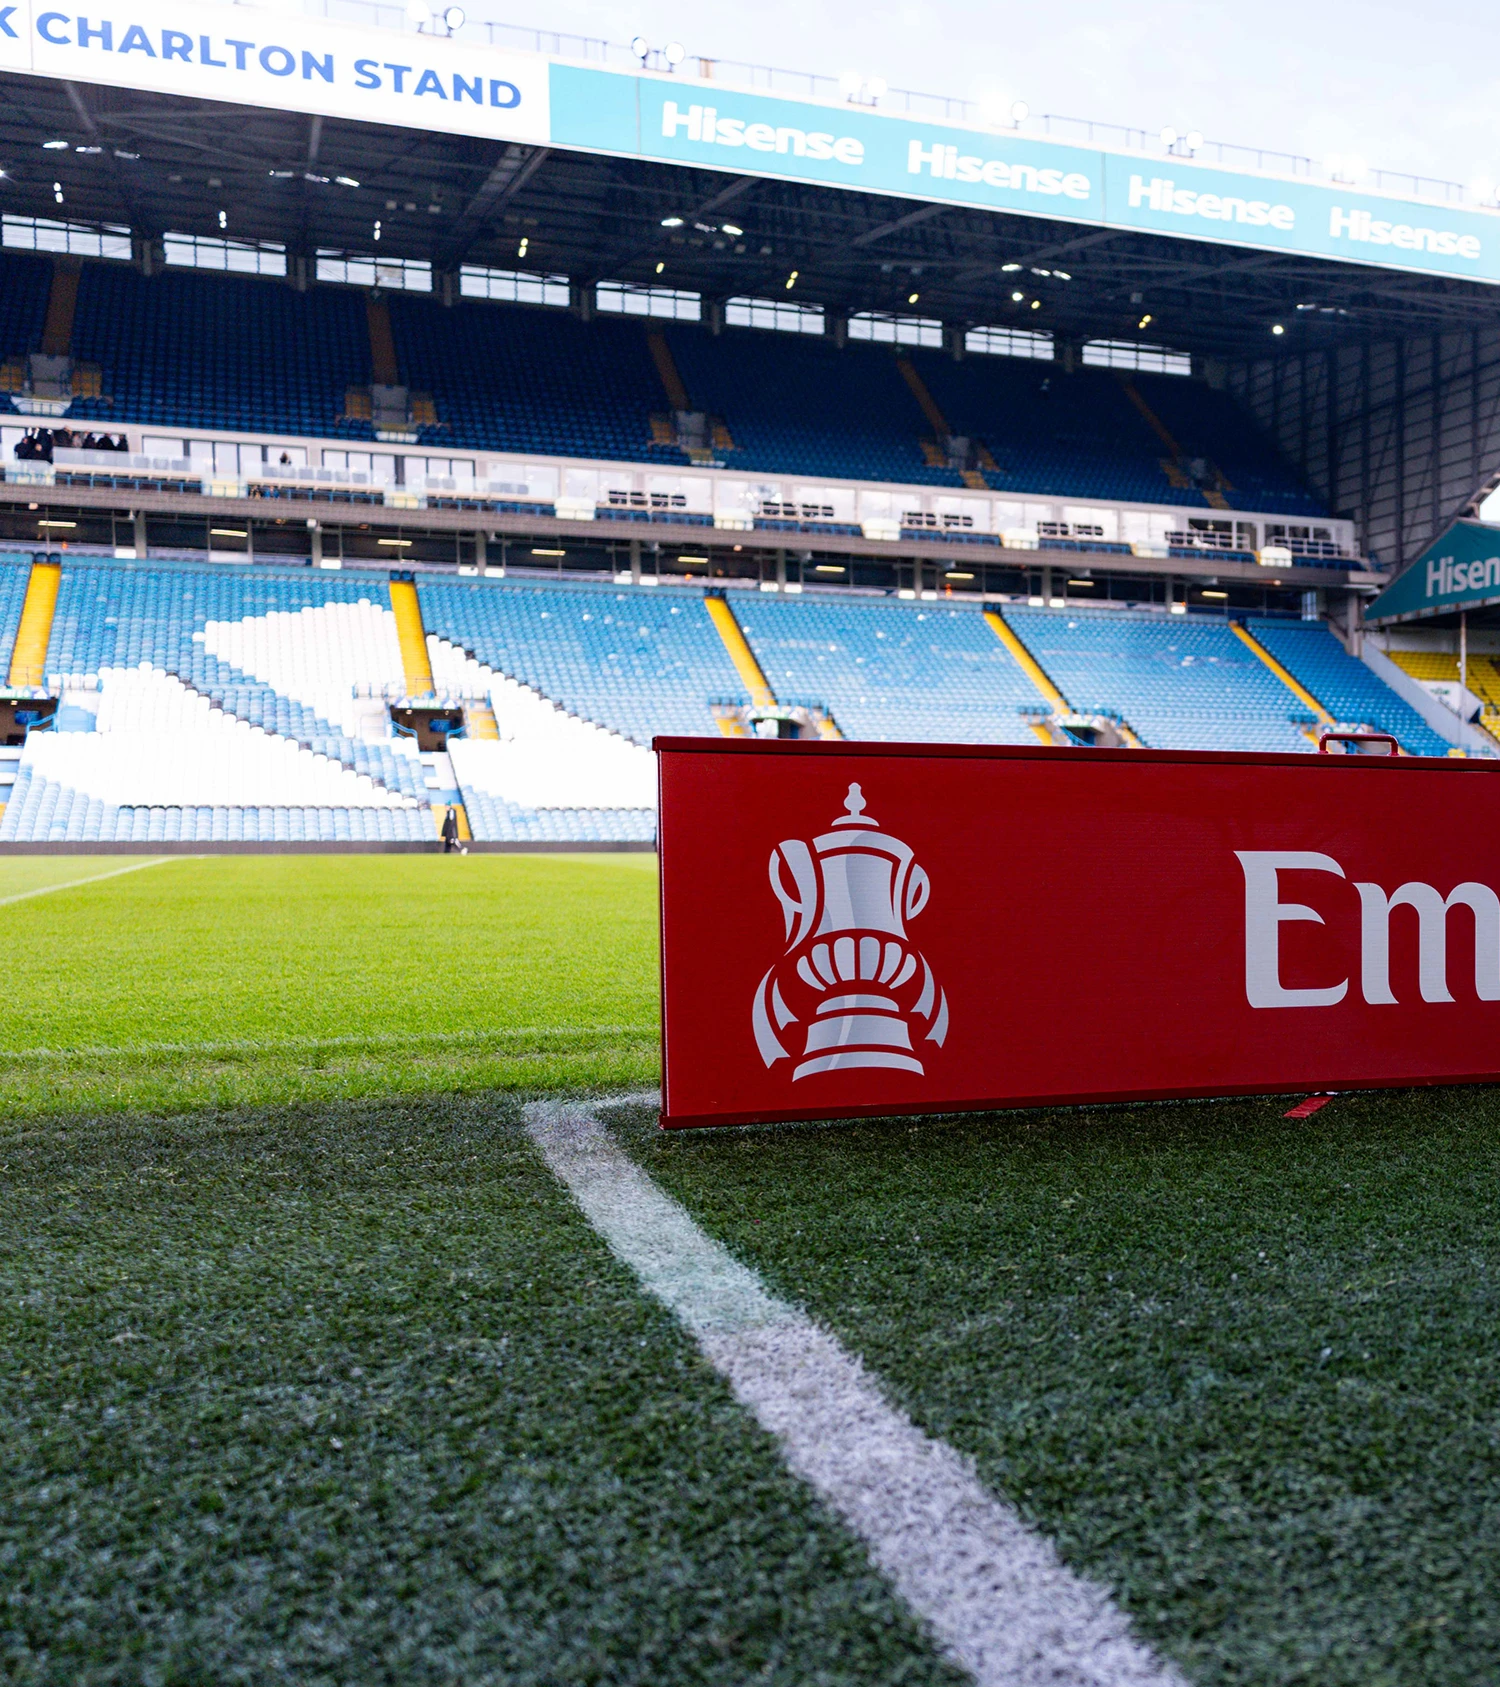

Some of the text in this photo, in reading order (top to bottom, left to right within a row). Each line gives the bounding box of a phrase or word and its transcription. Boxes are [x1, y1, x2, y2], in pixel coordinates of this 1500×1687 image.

[36, 11, 334, 83] CHARLTON
[354, 58, 521, 109] STAND
[662, 101, 865, 165] Hisense
[907, 139, 1091, 199] Hisense
[1128, 174, 1295, 230] Hisense
[1330, 206, 1481, 259] Hisense
